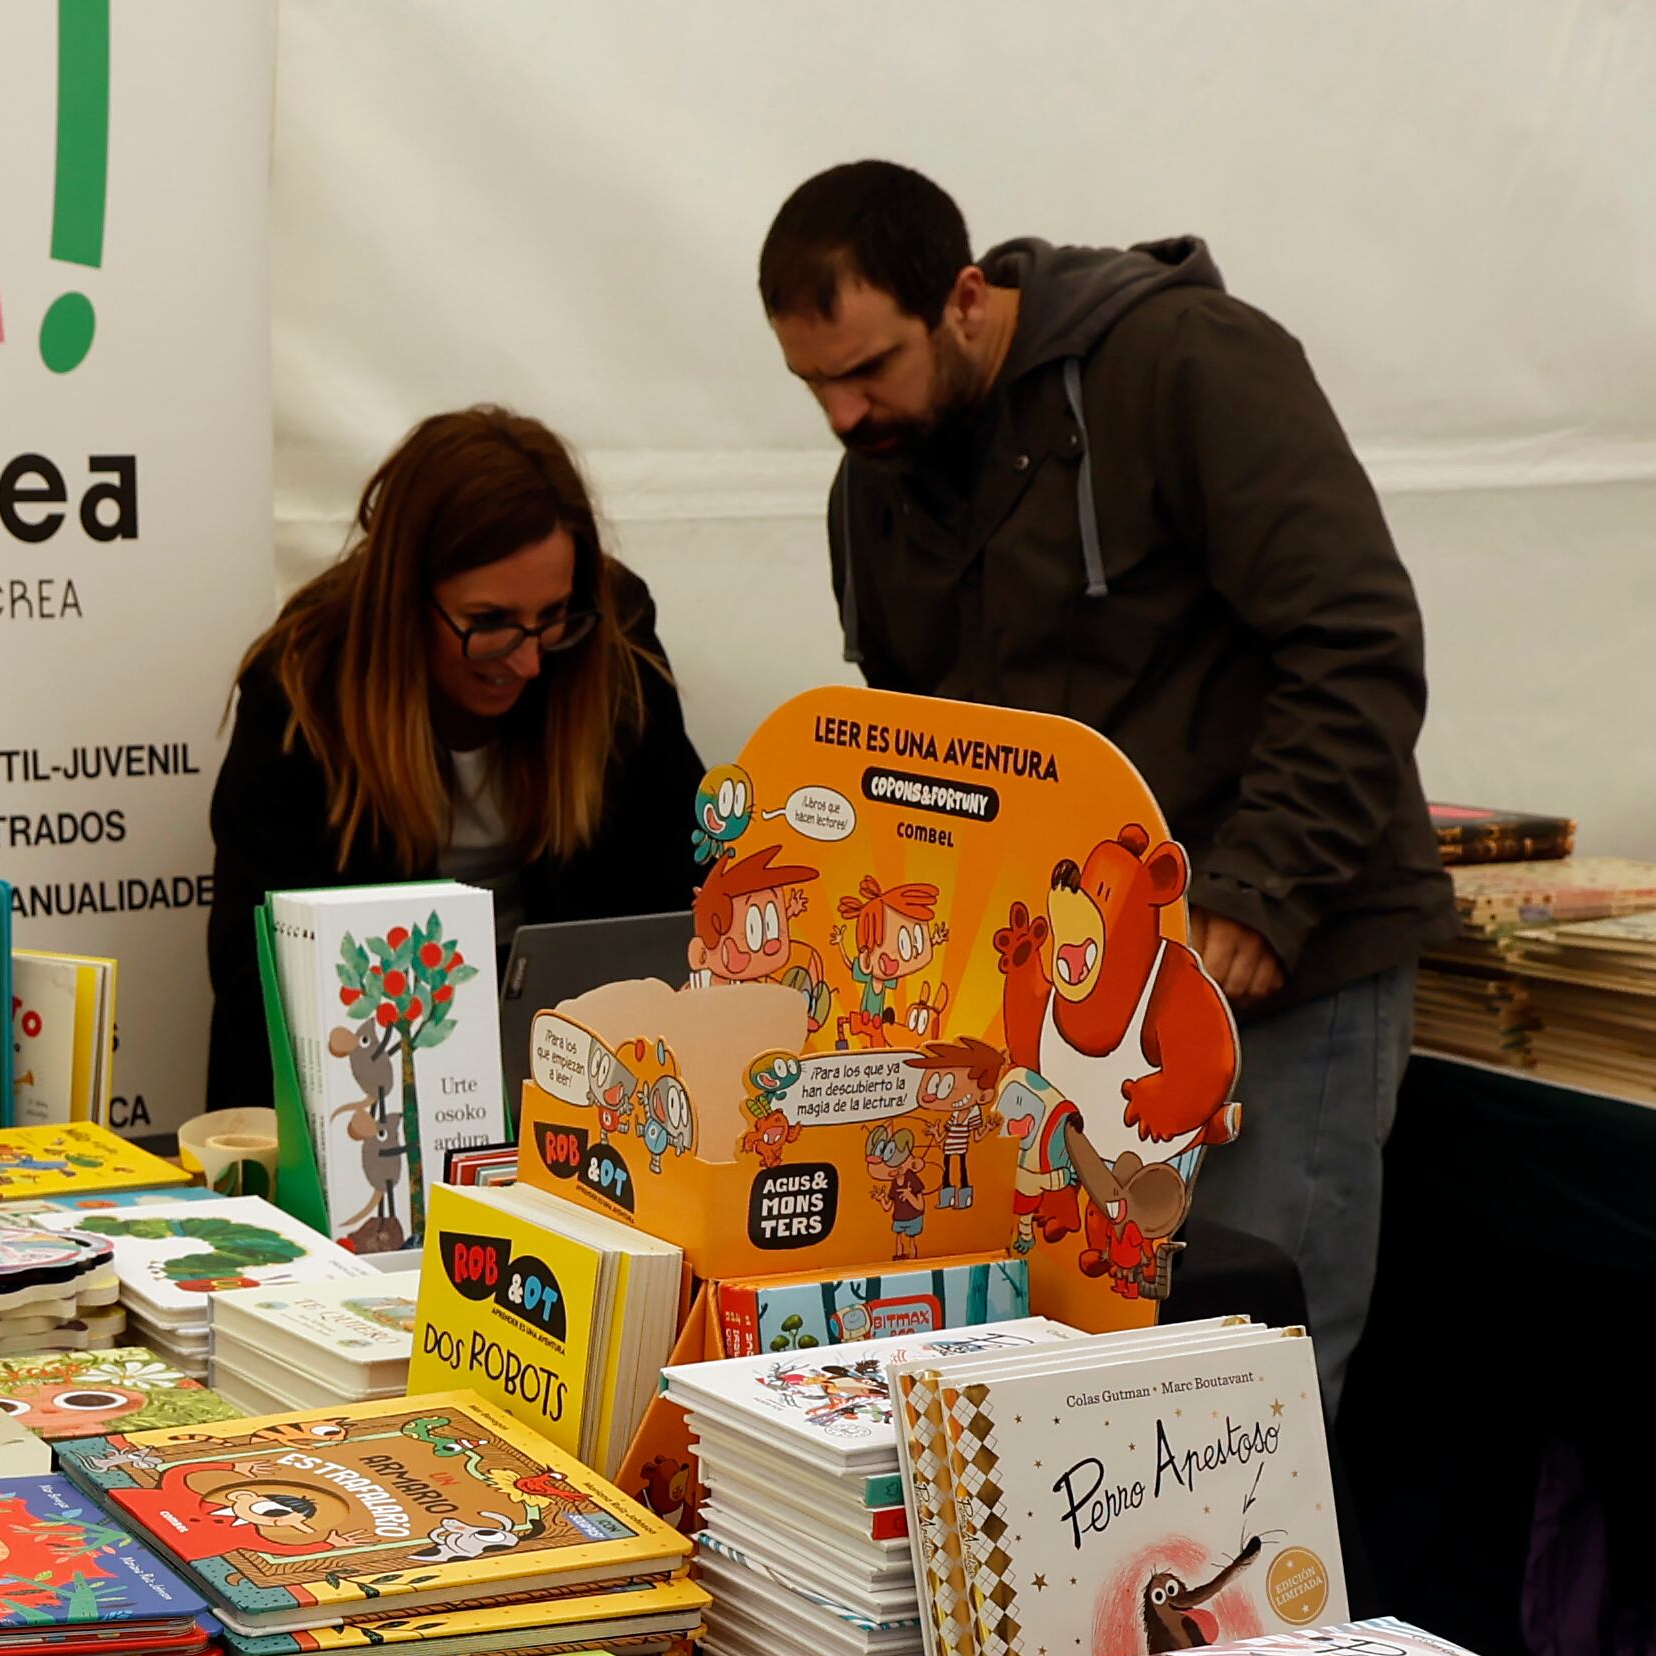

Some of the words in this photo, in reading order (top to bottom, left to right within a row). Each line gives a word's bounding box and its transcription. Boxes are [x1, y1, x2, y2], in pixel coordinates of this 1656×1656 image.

[814, 716, 861, 750] LEER
[866, 724, 890, 753] ES
[894, 728, 940, 763] UNA
[942, 737, 1060, 783] AVENTURA
[870, 774, 991, 818] COPONS&FORTUNY
[9, 873, 216, 918] ANUALIDADE
[551, 1050, 586, 1079] empiezan
[810, 1064, 840, 1081] ¡Para
[843, 1063, 861, 1079] los
[863, 1064, 884, 1079] que
[885, 1062, 900, 1077] ya
[440, 1076, 478, 1096] Urte
[802, 1084, 824, 1099] han
[825, 1080, 893, 1098] descubierto
[896, 1077, 906, 1091] la
[434, 1101, 488, 1125] osoko
[797, 1100, 831, 1118] magia
[833, 1099, 847, 1113] de
[849, 1097, 860, 1111] la
[862, 1093, 908, 1110] lectura!
[433, 1127, 491, 1153] ardura
[545, 1131, 581, 1167] ROB
[762, 1170, 829, 1195] AGUS&
[761, 1193, 824, 1217] MONS
[760, 1215, 822, 1239] TERS
[453, 1241, 500, 1288] ROB
[873, 1309, 931, 1332] BITMAX
[424, 1322, 465, 1371] DOS
[468, 1329, 568, 1423] ROBOTS
[1066, 1392, 1097, 1409] Colas
[1100, 1387, 1151, 1406] Gutman
[1161, 1378, 1195, 1396] Marc
[1196, 1370, 1255, 1393] Boutavant
[358, 1454, 460, 1517] ARMARIO
[428, 1470, 458, 1489] UN
[1052, 1456, 1146, 1551] Perro
[1153, 1414, 1284, 1501] Apestoso
[276, 1452, 418, 1540] ESTRAFALARIO
[1274, 1571, 1325, 1607] LIMITADA
[1275, 1563, 1320, 1596] EDICIÓN
